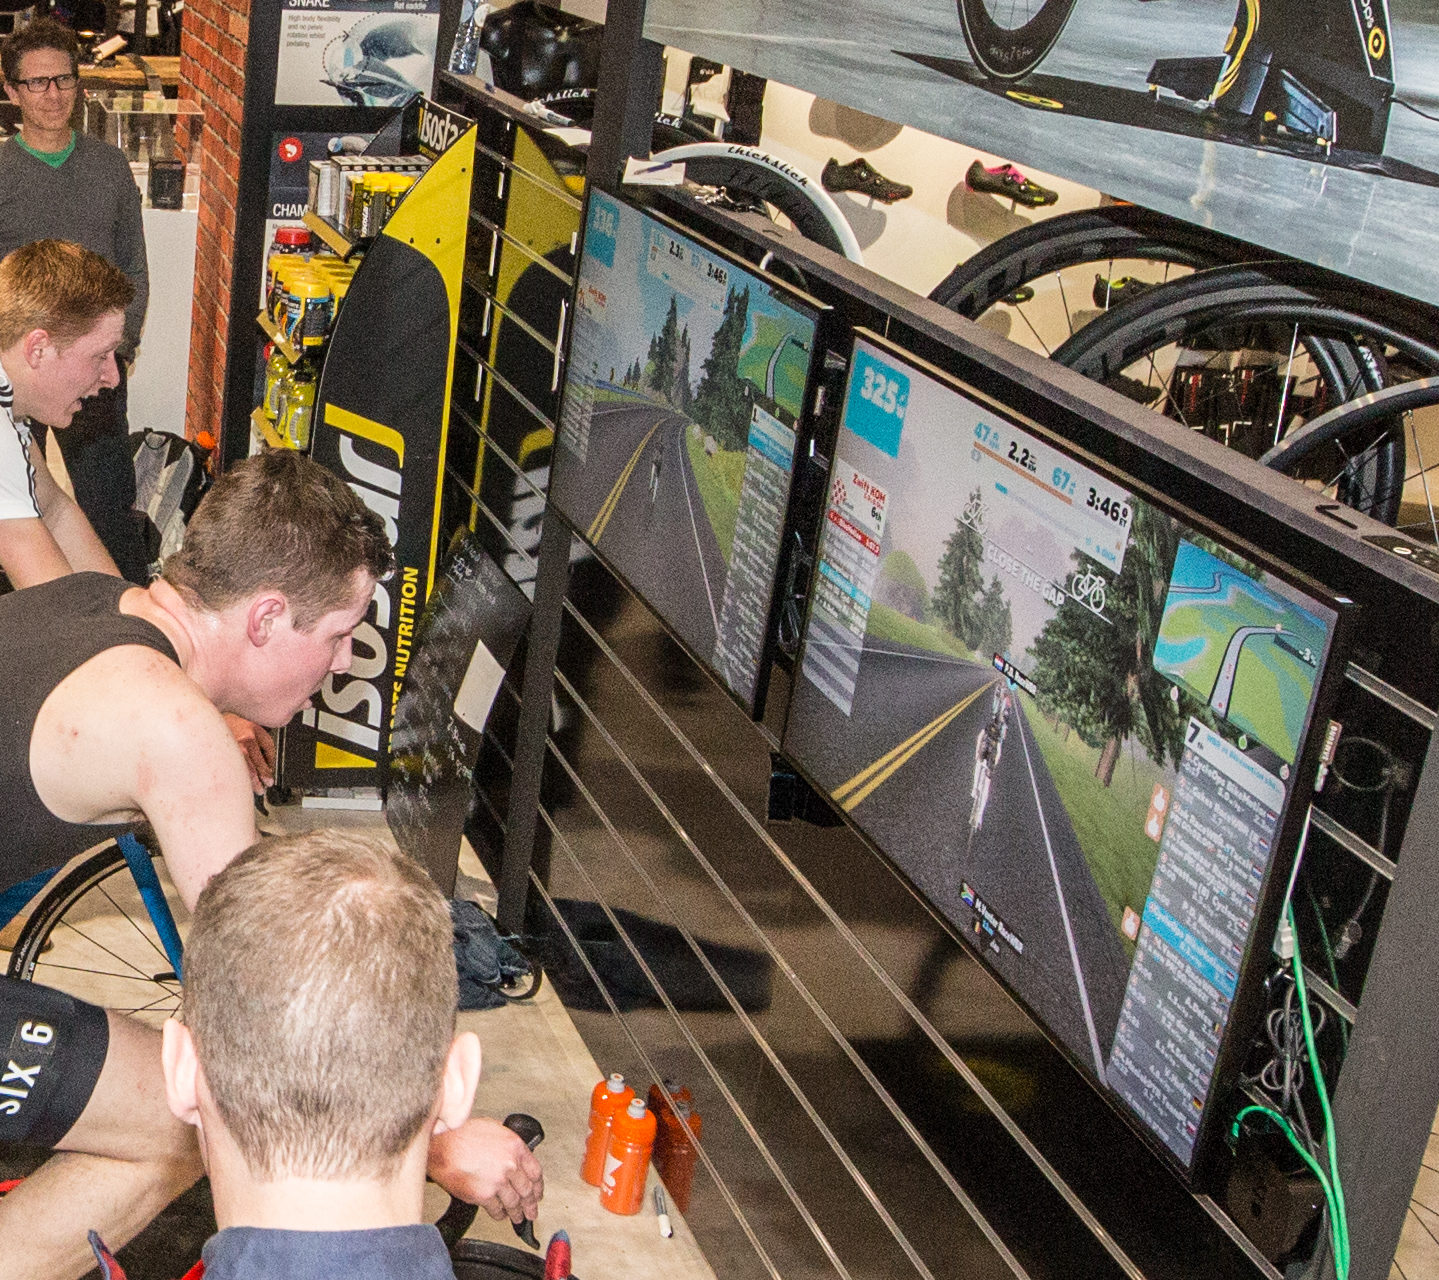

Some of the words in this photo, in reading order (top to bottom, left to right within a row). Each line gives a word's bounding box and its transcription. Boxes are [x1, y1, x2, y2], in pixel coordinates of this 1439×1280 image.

[727, 144, 809, 189] thickslick
[860, 365, 899, 415] 325
[1086, 487, 1121, 521] 3:46
[988, 543, 1020, 579] CLOSE
[1022, 572, 1041, 594] THE
[1043, 584, 1066, 607] GAP
[394, 566, 419, 678] NUTRITION
[20, 1017, 55, 1049] 6
